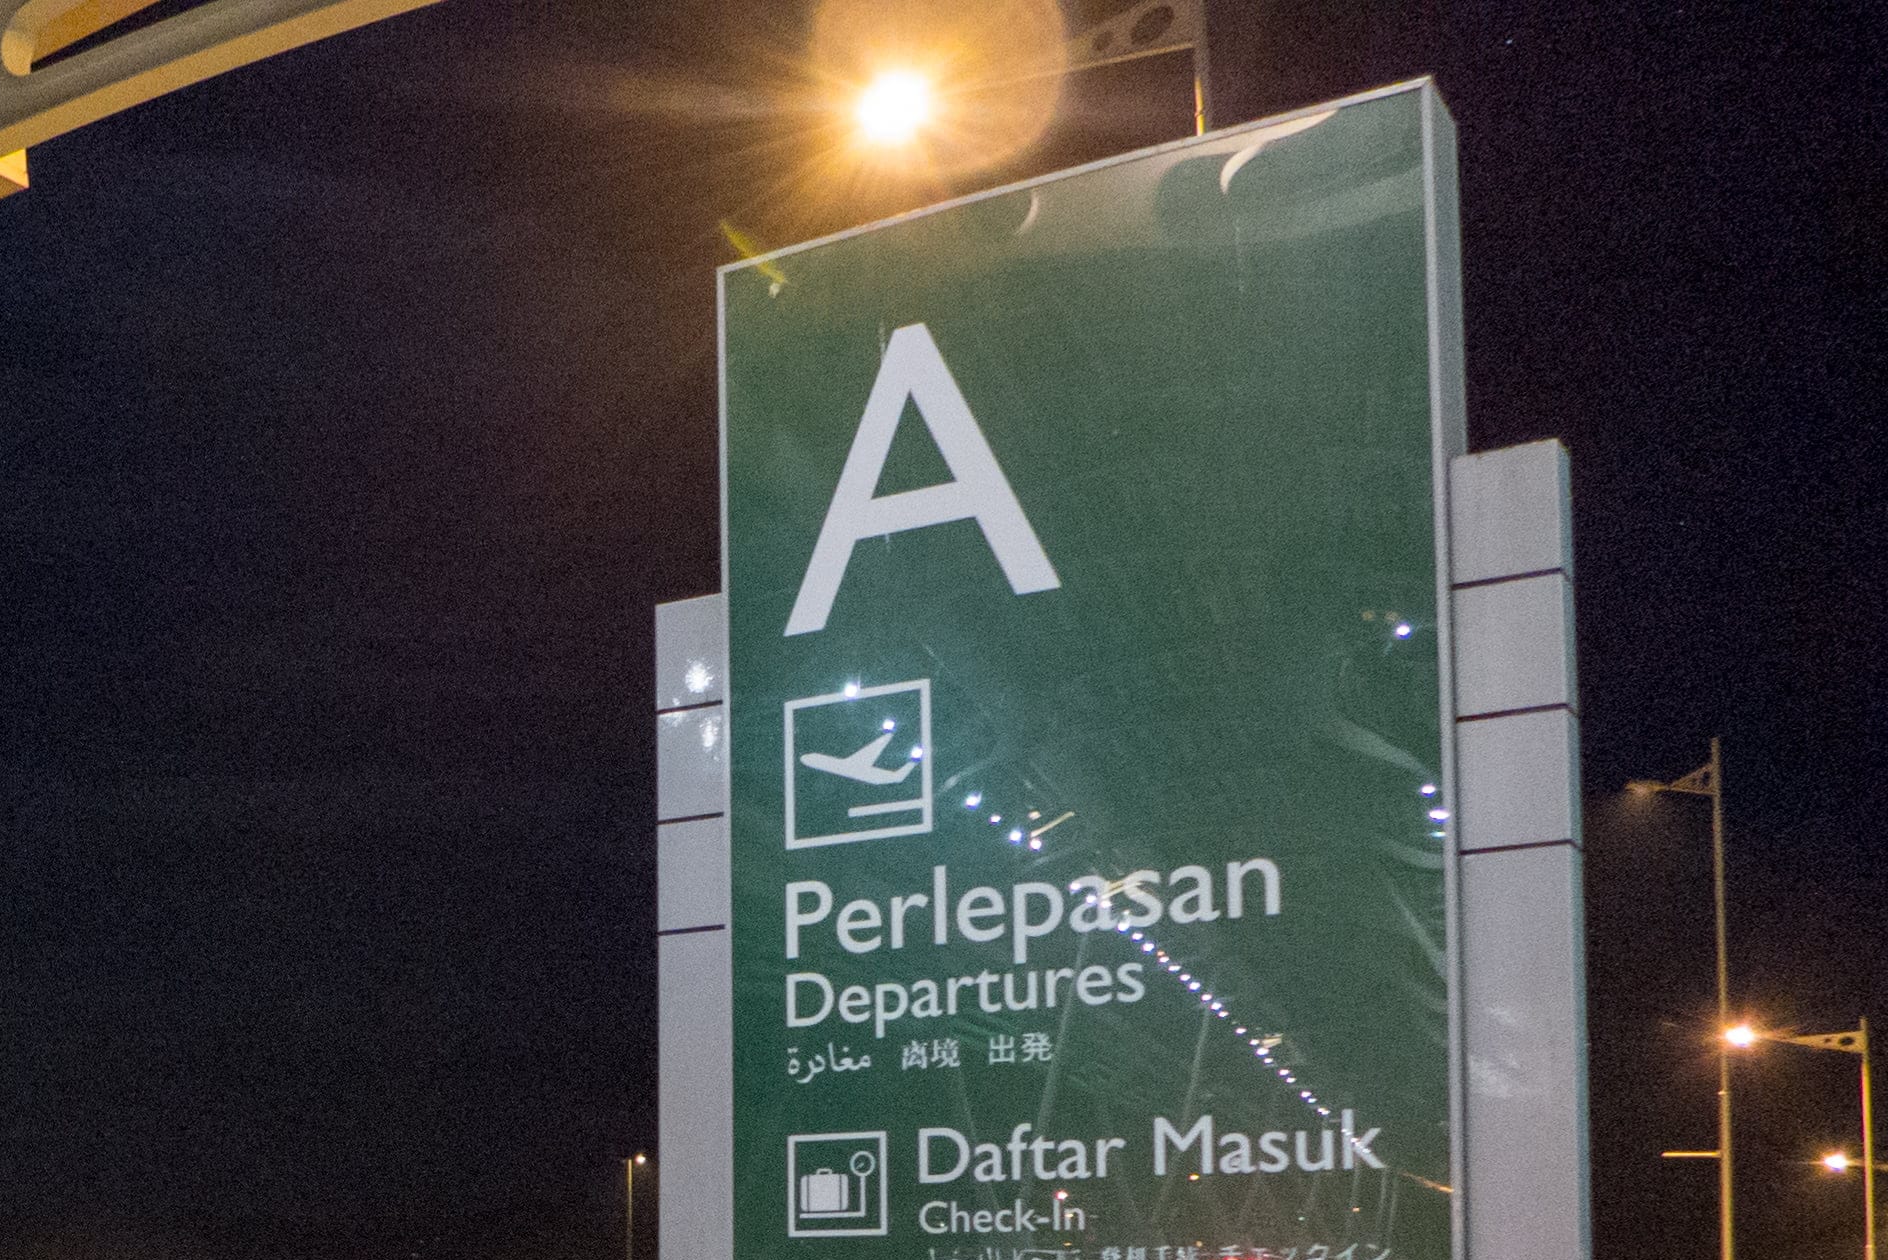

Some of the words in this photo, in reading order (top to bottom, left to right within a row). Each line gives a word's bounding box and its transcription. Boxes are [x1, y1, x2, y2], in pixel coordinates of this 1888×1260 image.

[783, 322, 1061, 637] A
[785, 856, 1281, 963] Perlepasan
[786, 960, 1146, 1037] Departures
[787, 1041, 872, 1084] مغادرة
[988, 1031, 1053, 1065] 出発
[918, 1122, 1126, 1184] Daftar
[1153, 1108, 1385, 1177] Masuk
[919, 1199, 1086, 1235] Check-In
